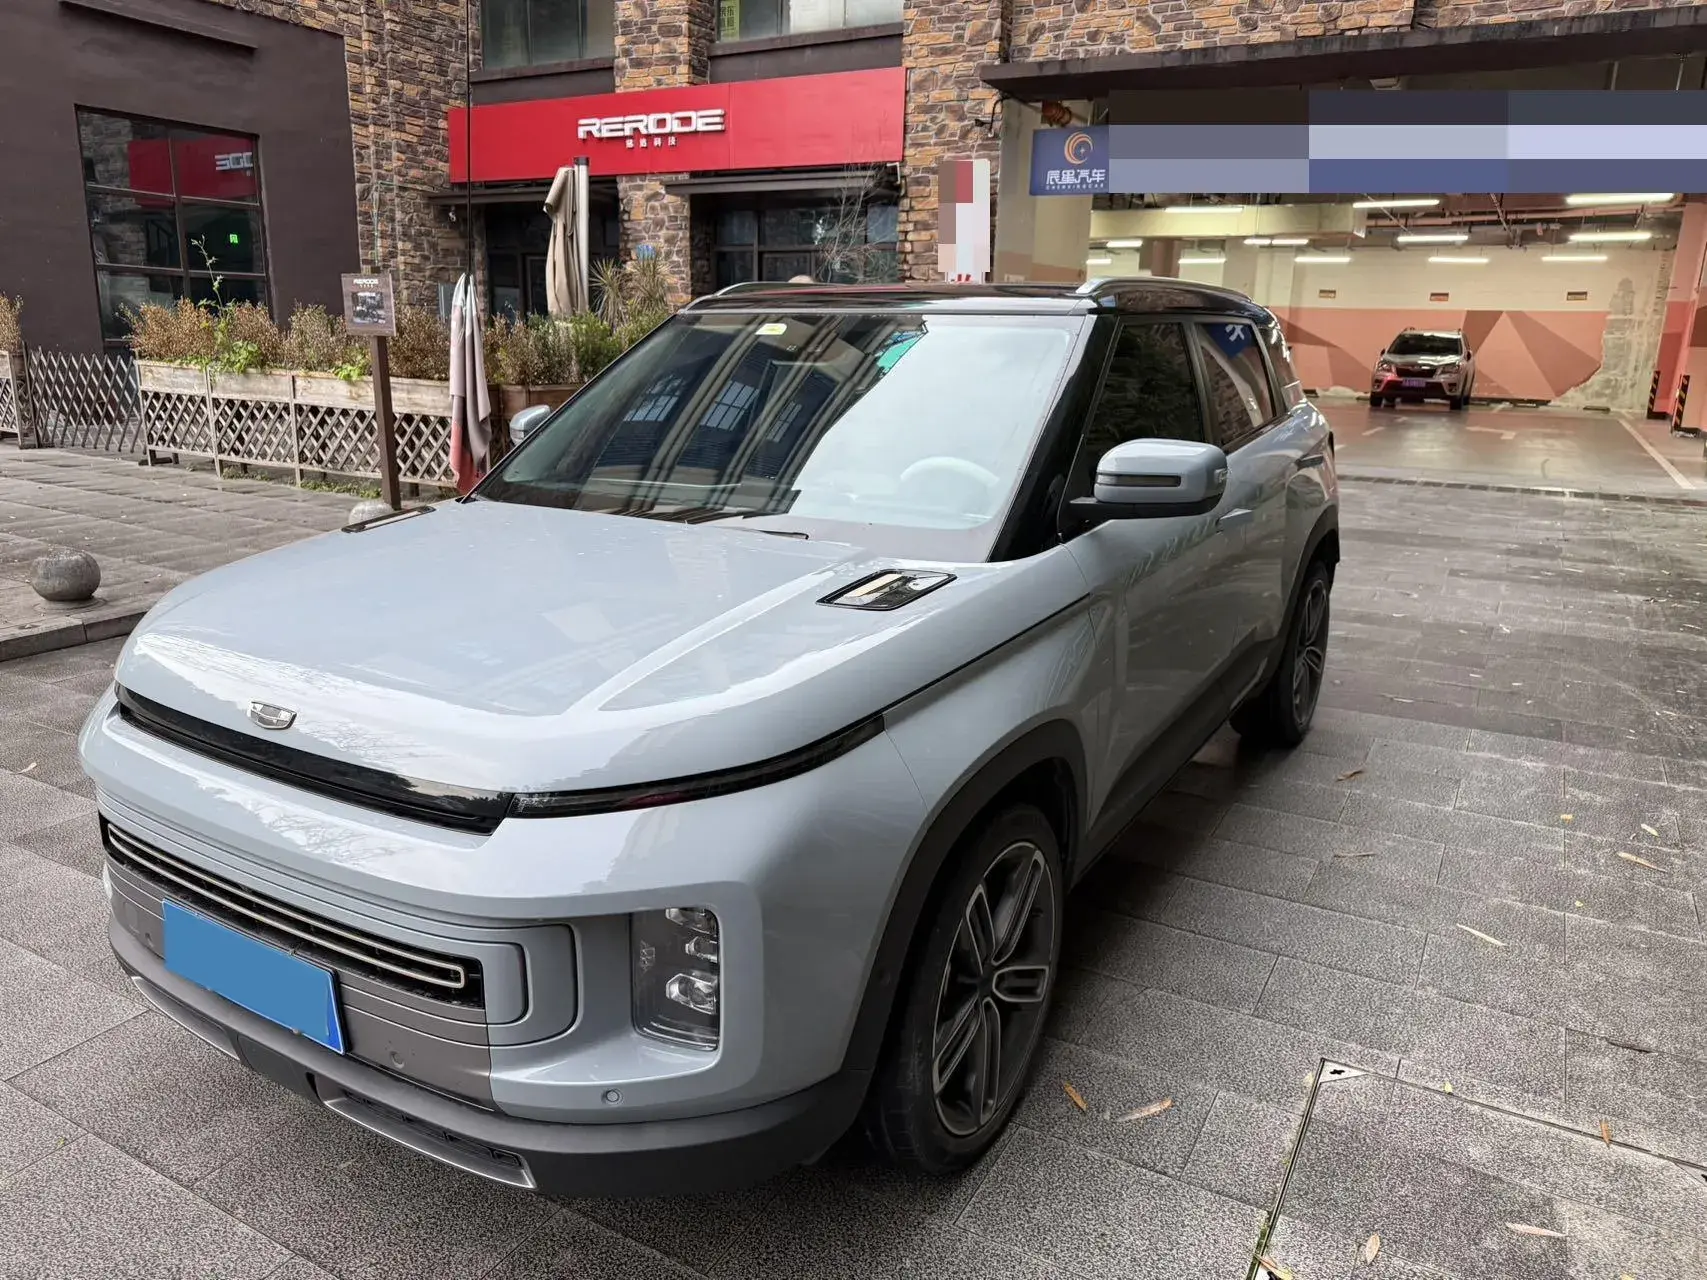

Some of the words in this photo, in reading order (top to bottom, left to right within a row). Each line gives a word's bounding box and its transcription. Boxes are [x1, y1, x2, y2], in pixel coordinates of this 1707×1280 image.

[577, 108, 725, 139] RERODE
[1045, 168, 1106, 184] 辰星汽车
